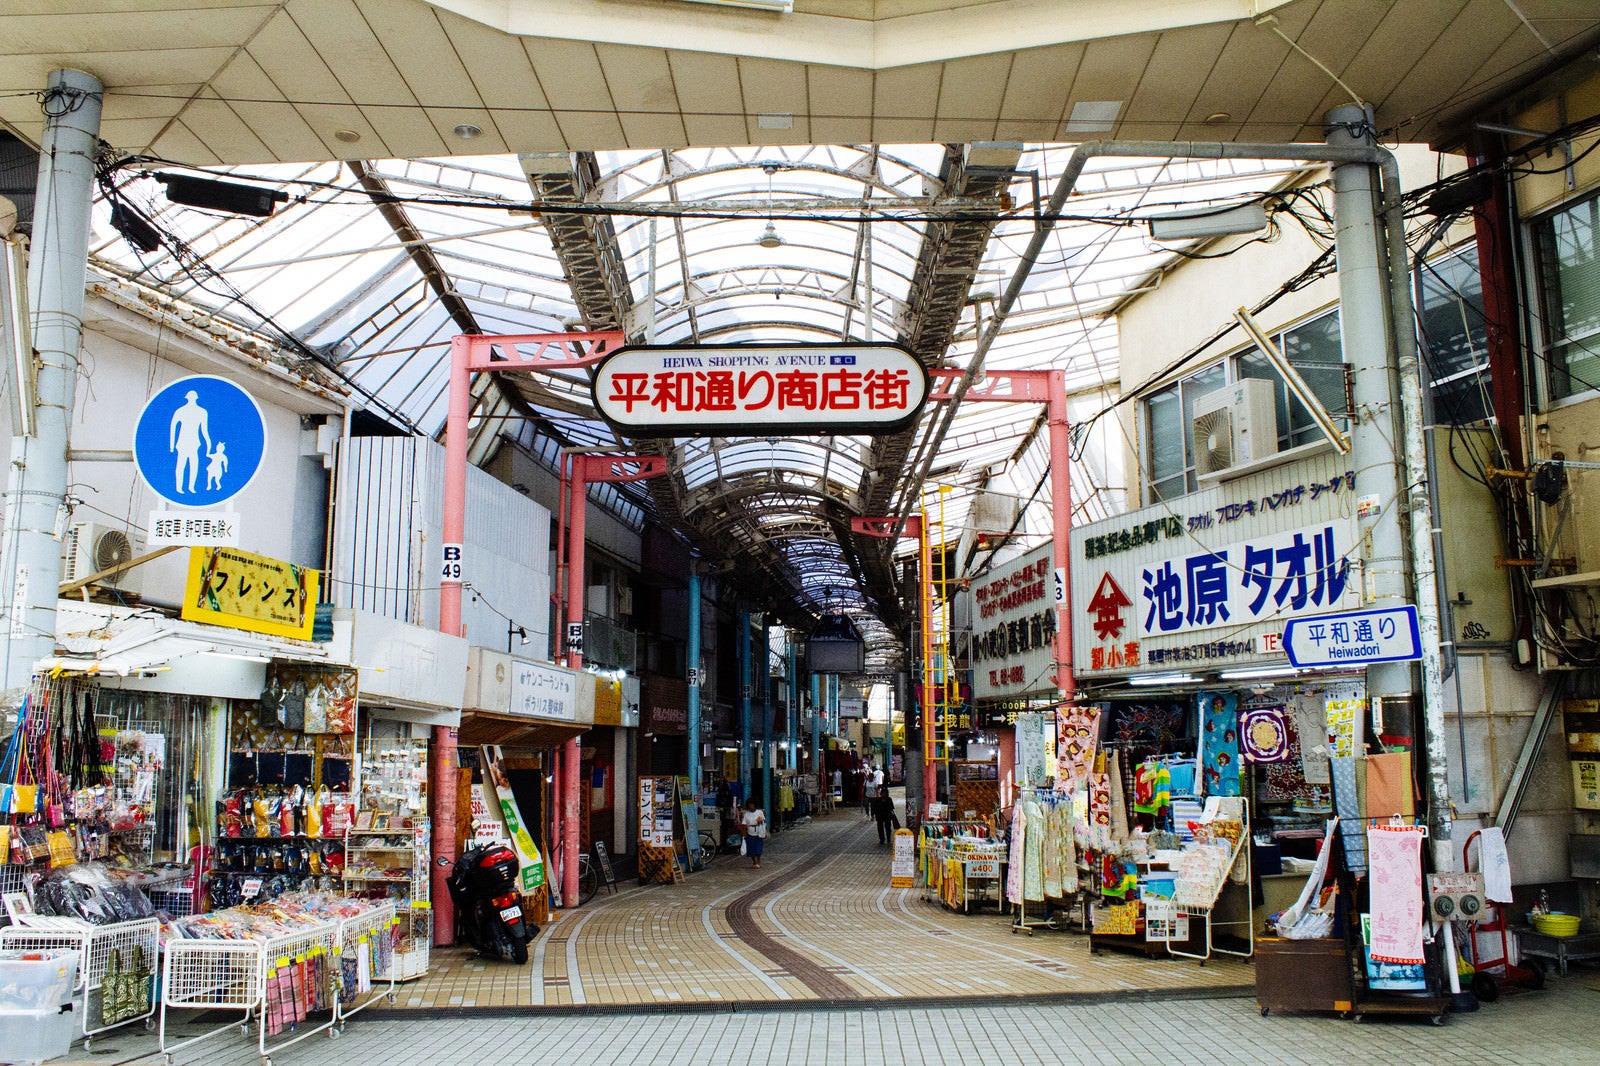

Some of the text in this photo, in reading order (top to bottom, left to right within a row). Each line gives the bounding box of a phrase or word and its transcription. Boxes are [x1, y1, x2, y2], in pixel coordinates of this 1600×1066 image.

[663, 357, 703, 368] HEIWA
[709, 356, 769, 367] SHOPPING
[775, 356, 826, 366] AVENUE
[609, 368, 910, 413] 平和通り商店街
[1187, 512, 1212, 533] タオル
[1216, 500, 1257, 524] フロシキ
[1260, 485, 1305, 512] ハンカチ
[444, 547, 461, 560] B
[442, 564, 461, 578] 49
[215, 571, 297, 609] フレンズ
[1308, 617, 1397, 646] 平和通り
[1328, 643, 1380, 660] Heiwadori
